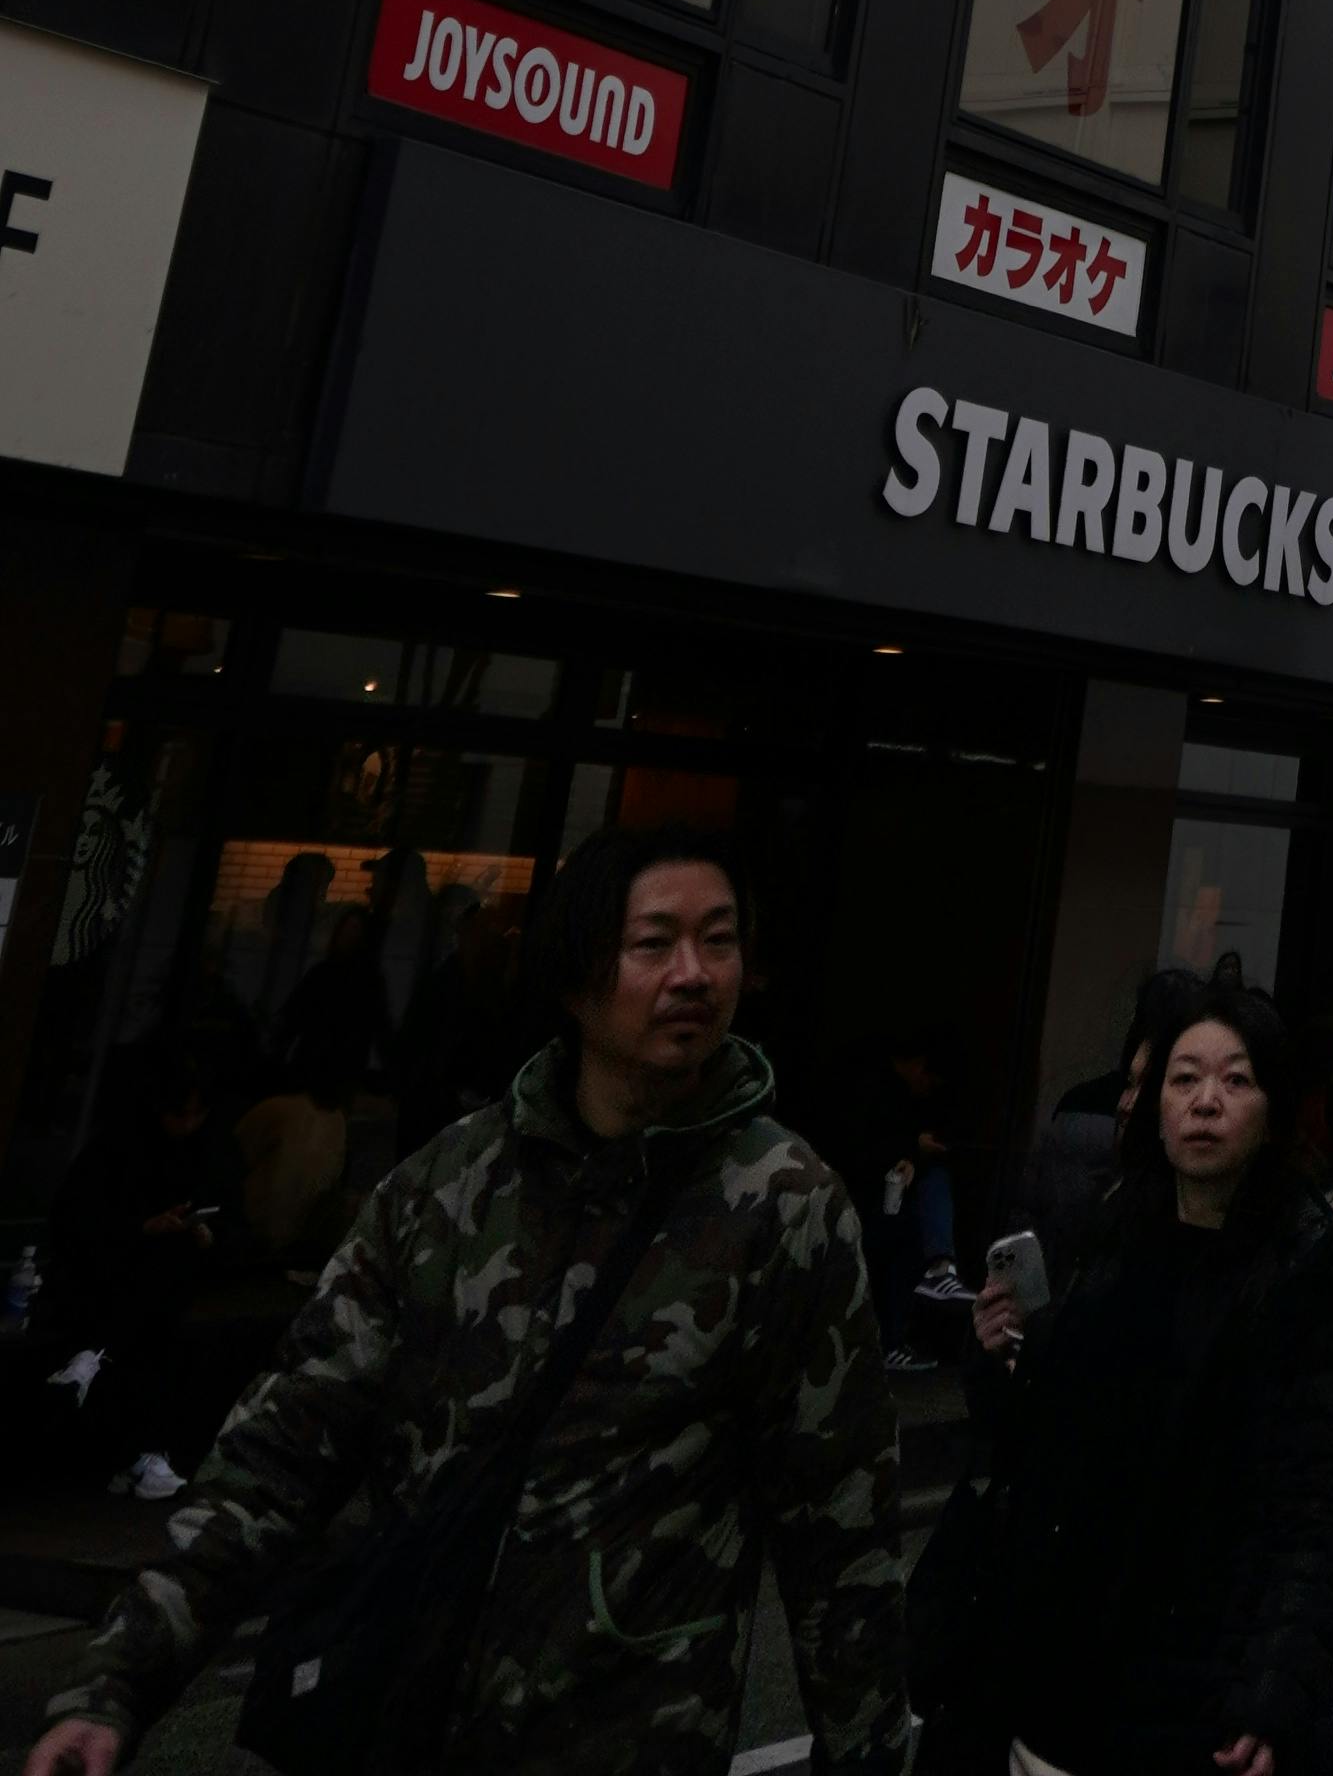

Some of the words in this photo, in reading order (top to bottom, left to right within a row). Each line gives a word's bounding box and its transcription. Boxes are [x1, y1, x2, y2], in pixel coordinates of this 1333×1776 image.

[403, 9, 655, 157] JOYSOUND
[954, 192, 1127, 317] カラオケ
